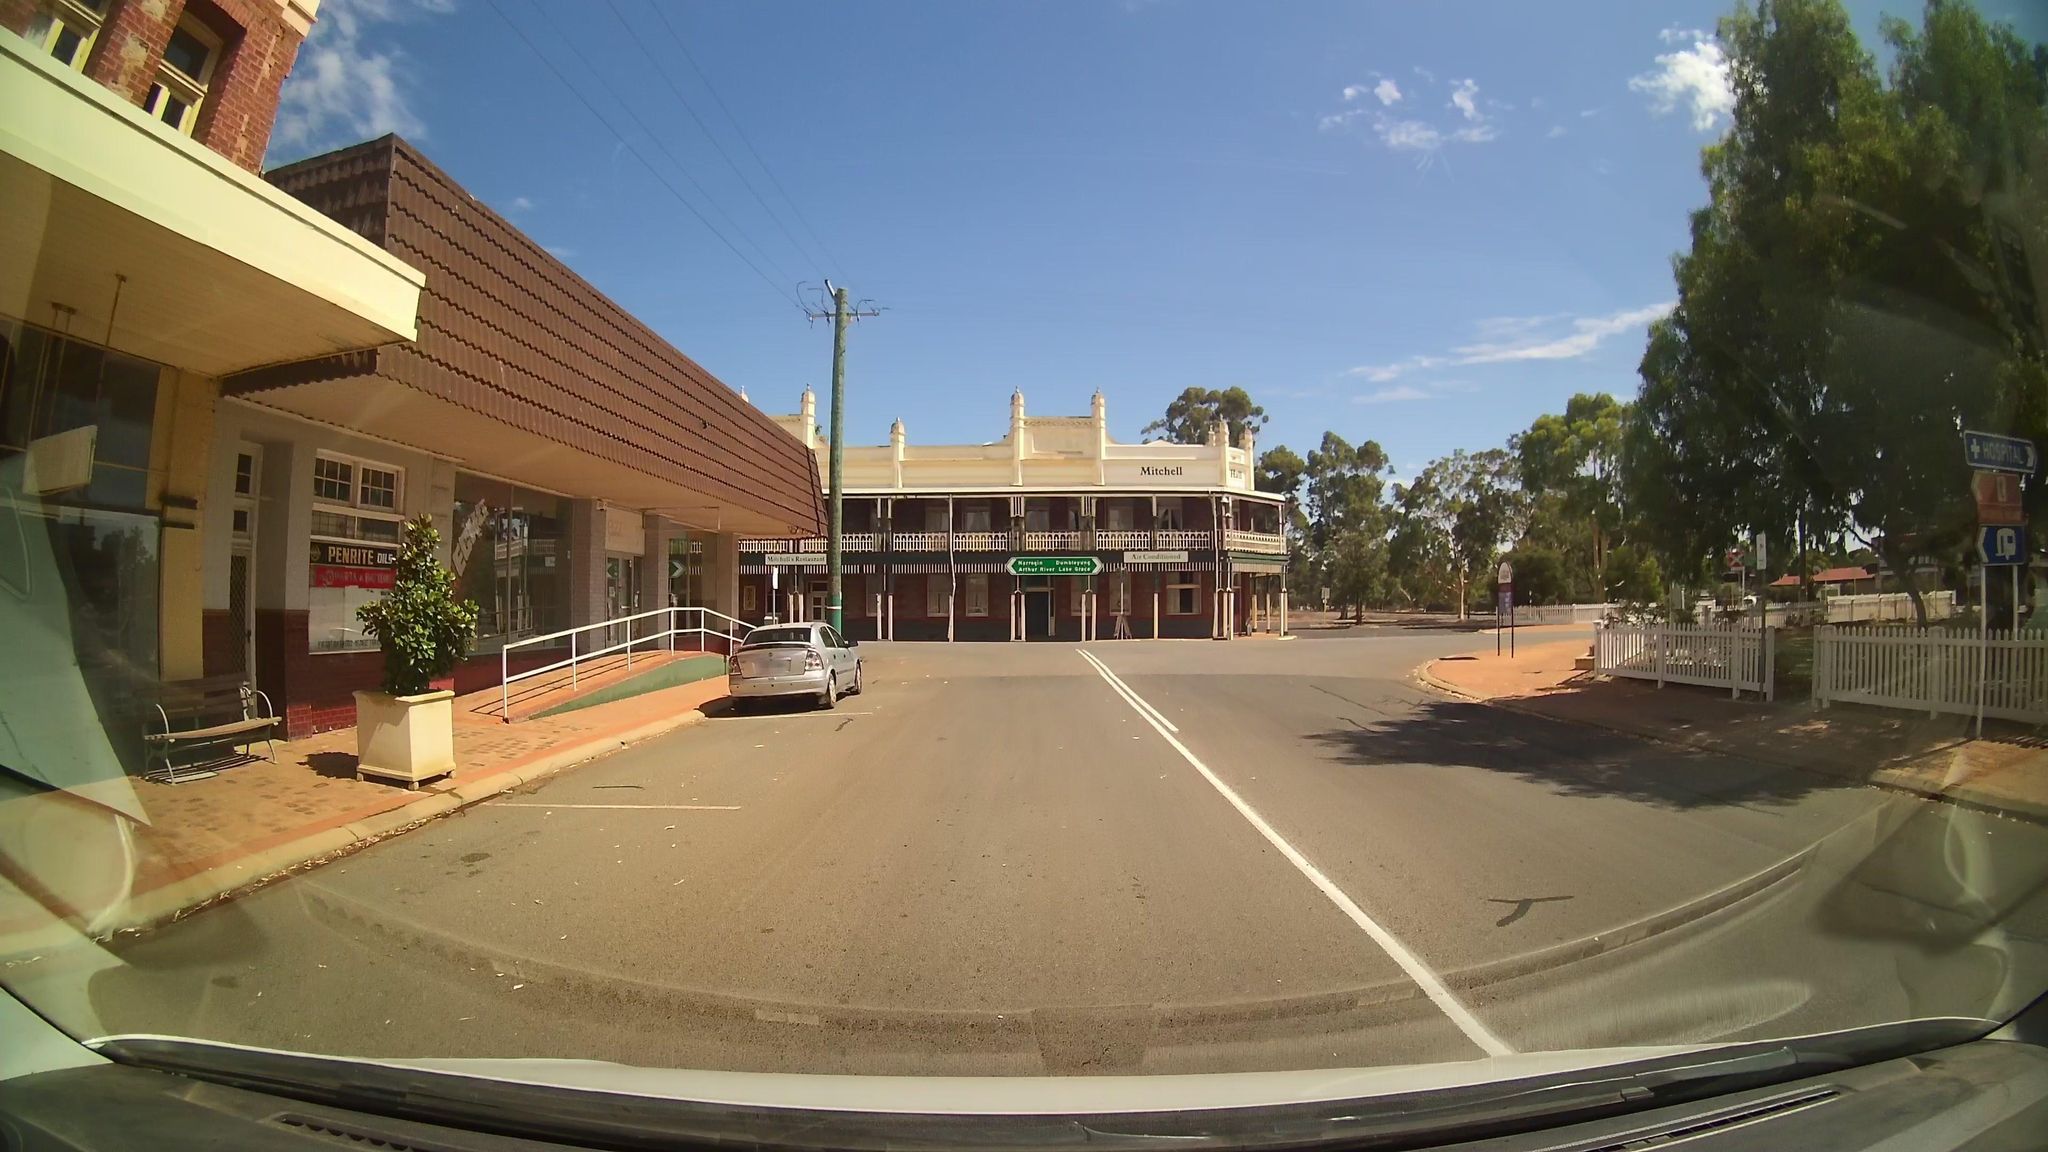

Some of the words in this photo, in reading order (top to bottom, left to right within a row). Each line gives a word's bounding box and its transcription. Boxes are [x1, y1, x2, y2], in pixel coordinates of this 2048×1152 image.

[1140, 466, 1183, 476] Mitchell
[328, 546, 374, 565] PENRITE
[376, 553, 393, 565] OILS
